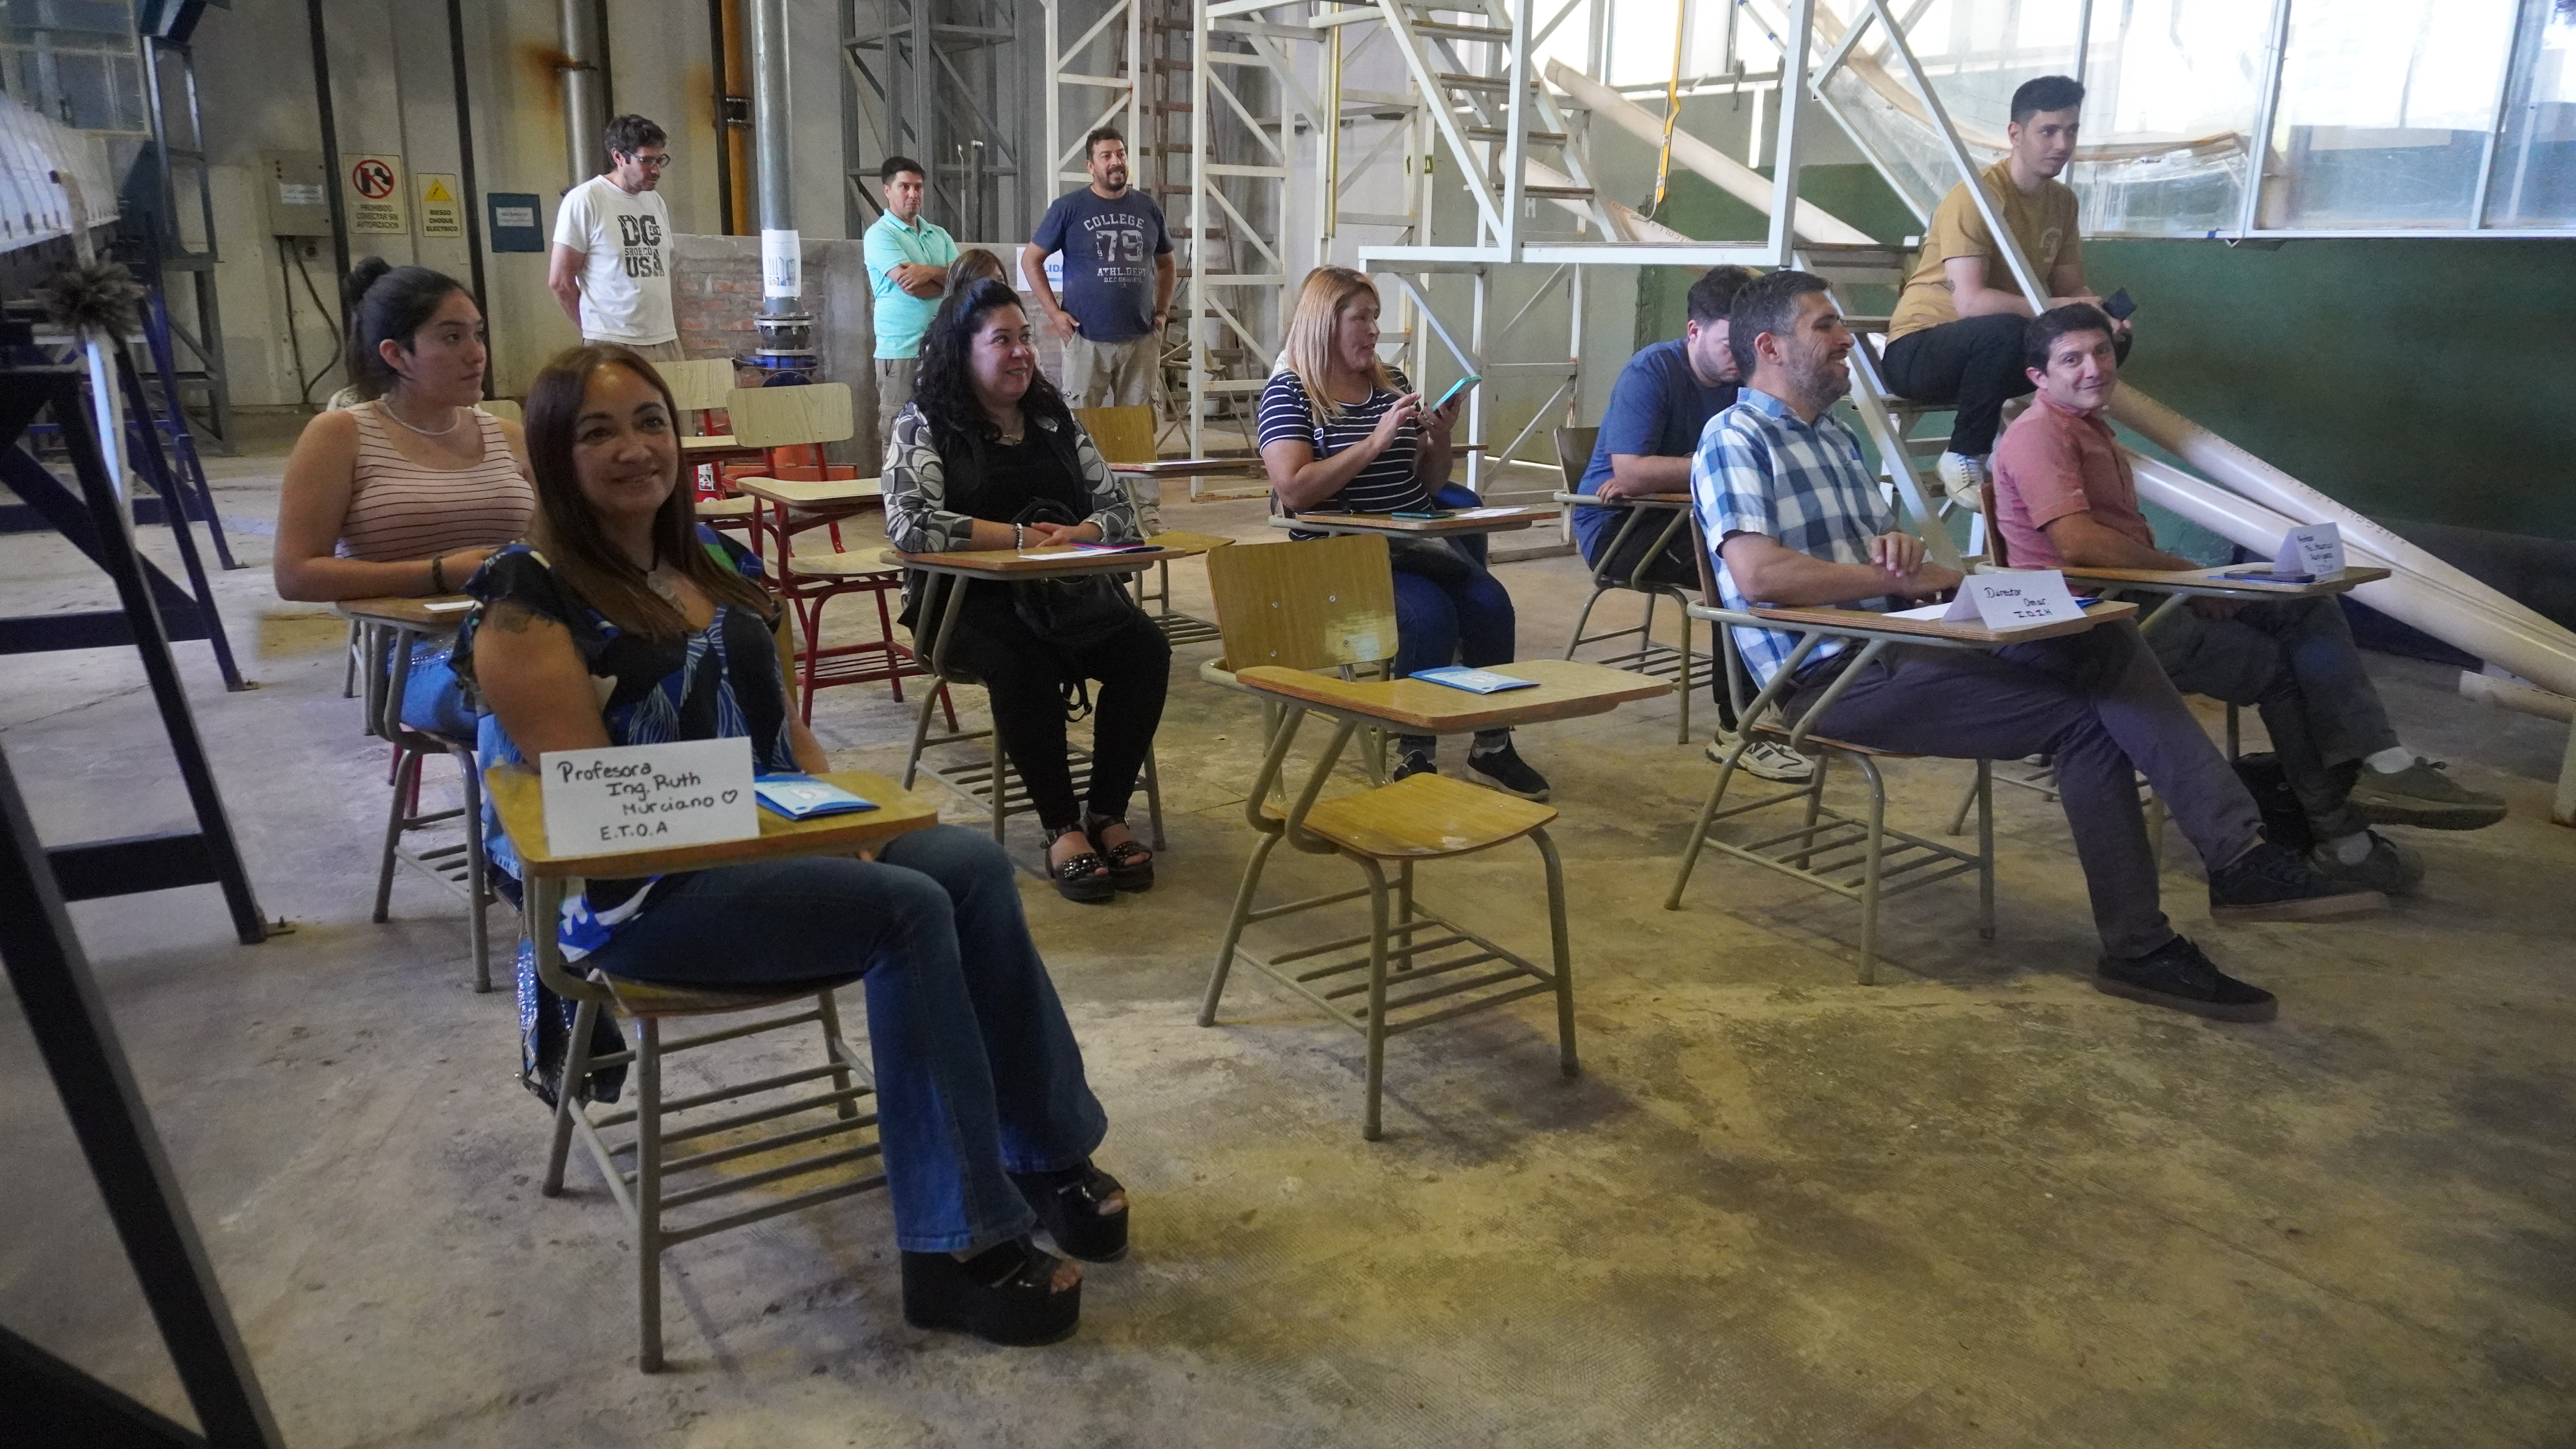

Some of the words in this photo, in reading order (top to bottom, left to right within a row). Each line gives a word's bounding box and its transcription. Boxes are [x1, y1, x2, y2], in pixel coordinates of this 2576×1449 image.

[617, 215, 660, 246] DC
[1083, 214, 1145, 230] COLLEGE
[1659, 225, 1689, 242] ICOLL
[1096, 230, 1143, 262] 79
[625, 249, 665, 278] USA
[556, 761, 652, 783] Profesora
[605, 782, 650, 802] Ing.
[652, 771, 702, 791] Ruth
[622, 796, 714, 816] Murciano
